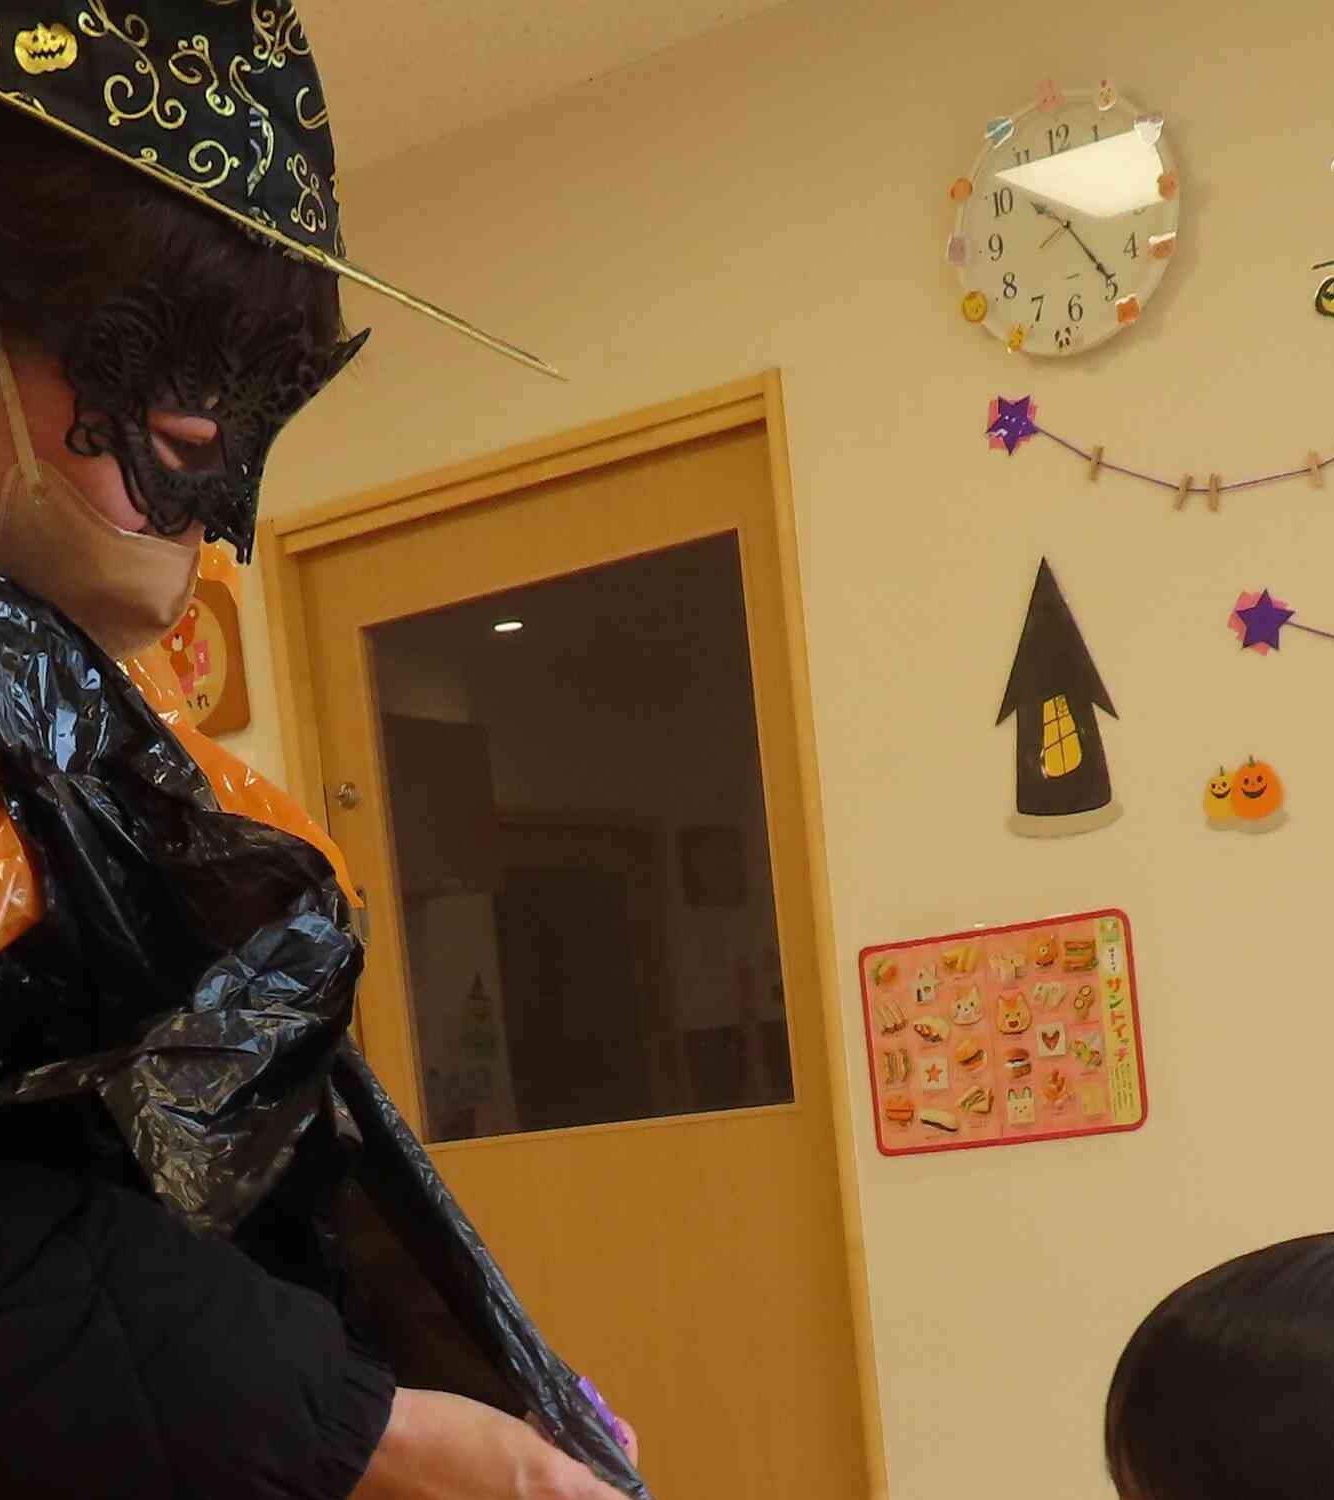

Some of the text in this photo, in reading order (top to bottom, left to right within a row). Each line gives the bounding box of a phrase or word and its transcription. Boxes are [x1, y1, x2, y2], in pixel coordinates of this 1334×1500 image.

[1045, 123, 1071, 156] 12
[992, 186, 1014, 217] 10
[987, 233, 1005, 262] 9
[1123, 232, 1140, 260] 4
[1002, 271, 1019, 300] 8
[1104, 272, 1120, 302] 5
[1030, 295, 1046, 323] 7
[1067, 293, 1084, 323] 6
